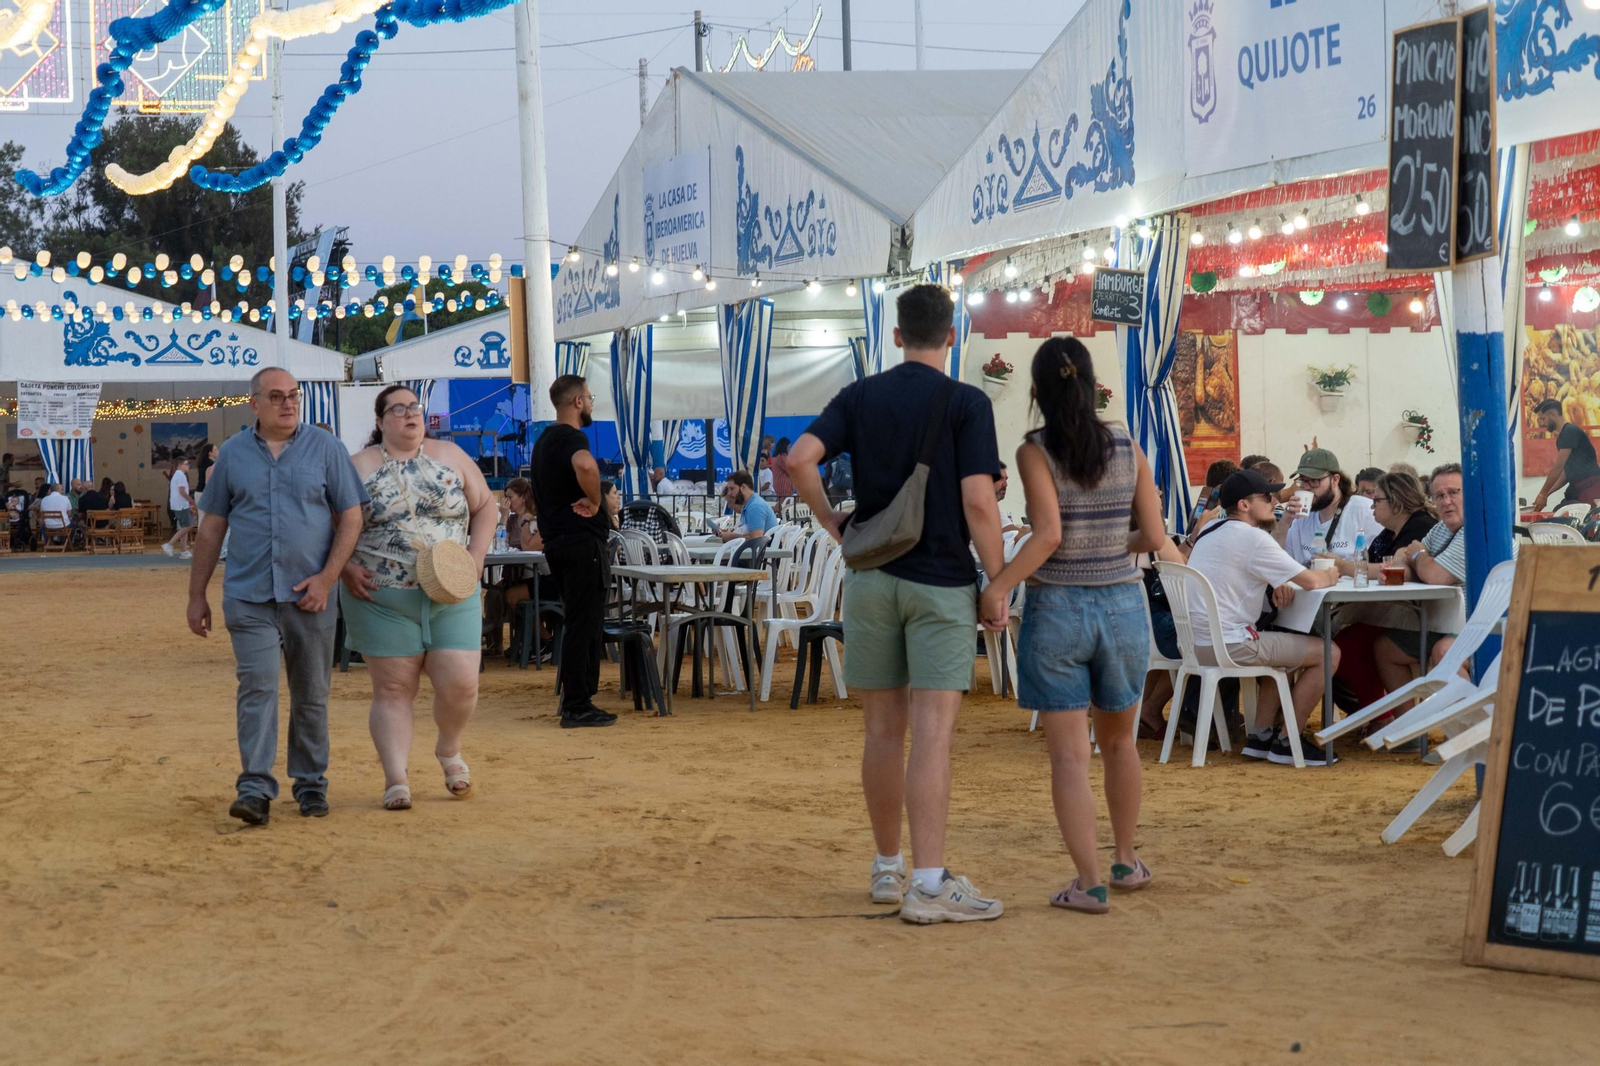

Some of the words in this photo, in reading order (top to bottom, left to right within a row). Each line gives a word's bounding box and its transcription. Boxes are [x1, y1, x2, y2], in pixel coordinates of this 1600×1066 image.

[1238, 23, 1342, 90] QUIJOTE
[1395, 39, 1456, 85] PINCHO
[1357, 94, 1377, 120] 26
[1393, 100, 1455, 142] MORUNO
[659, 192, 667, 210] LA
[667, 186, 685, 207] CASA
[687, 182, 697, 201] DE
[655, 211, 706, 239] IBEROAMERICA
[661, 247, 670, 265] DE
[671, 241, 698, 263] HUELVA
[1127, 295, 1142, 320] 3
[1529, 686, 1565, 726] DE
[1514, 743, 1570, 777] CON
[949, 891, 963, 903] N
